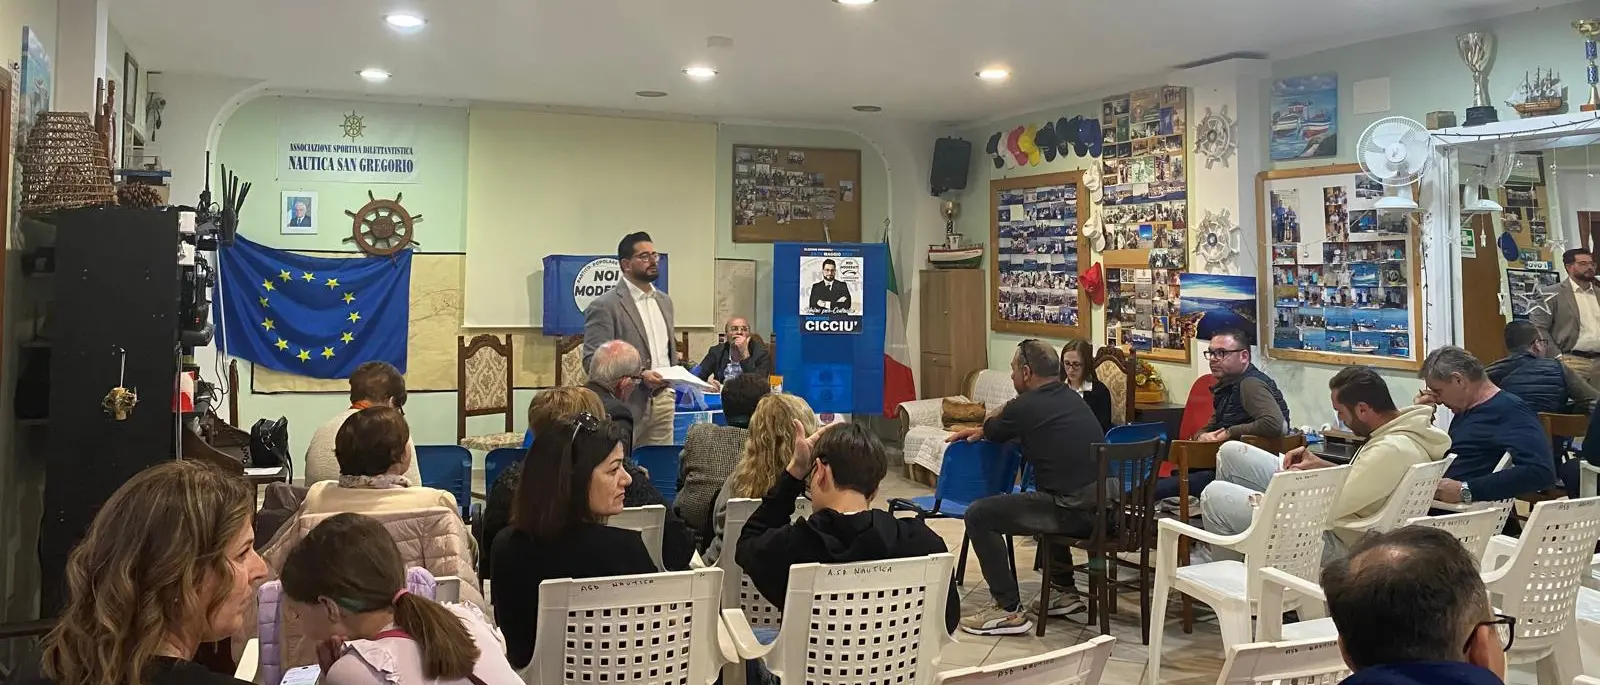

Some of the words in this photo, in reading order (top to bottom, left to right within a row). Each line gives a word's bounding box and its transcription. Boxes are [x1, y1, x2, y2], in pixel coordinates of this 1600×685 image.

[290, 143, 331, 152] ASSOCIAZIONE
[333, 145, 362, 153] SPORTIVA
[363, 146, 413, 155] DILETTANTISTICA
[288, 156, 334, 171] NAUTICA
[337, 158, 356, 171] SAN
[359, 158, 413, 172] GREGORIO
[594, 270, 620, 281] NOI
[575, 285, 616, 296] MODE
[854, 565, 892, 575] NAUTICA
[612, 579, 654, 588] NAUTICA
